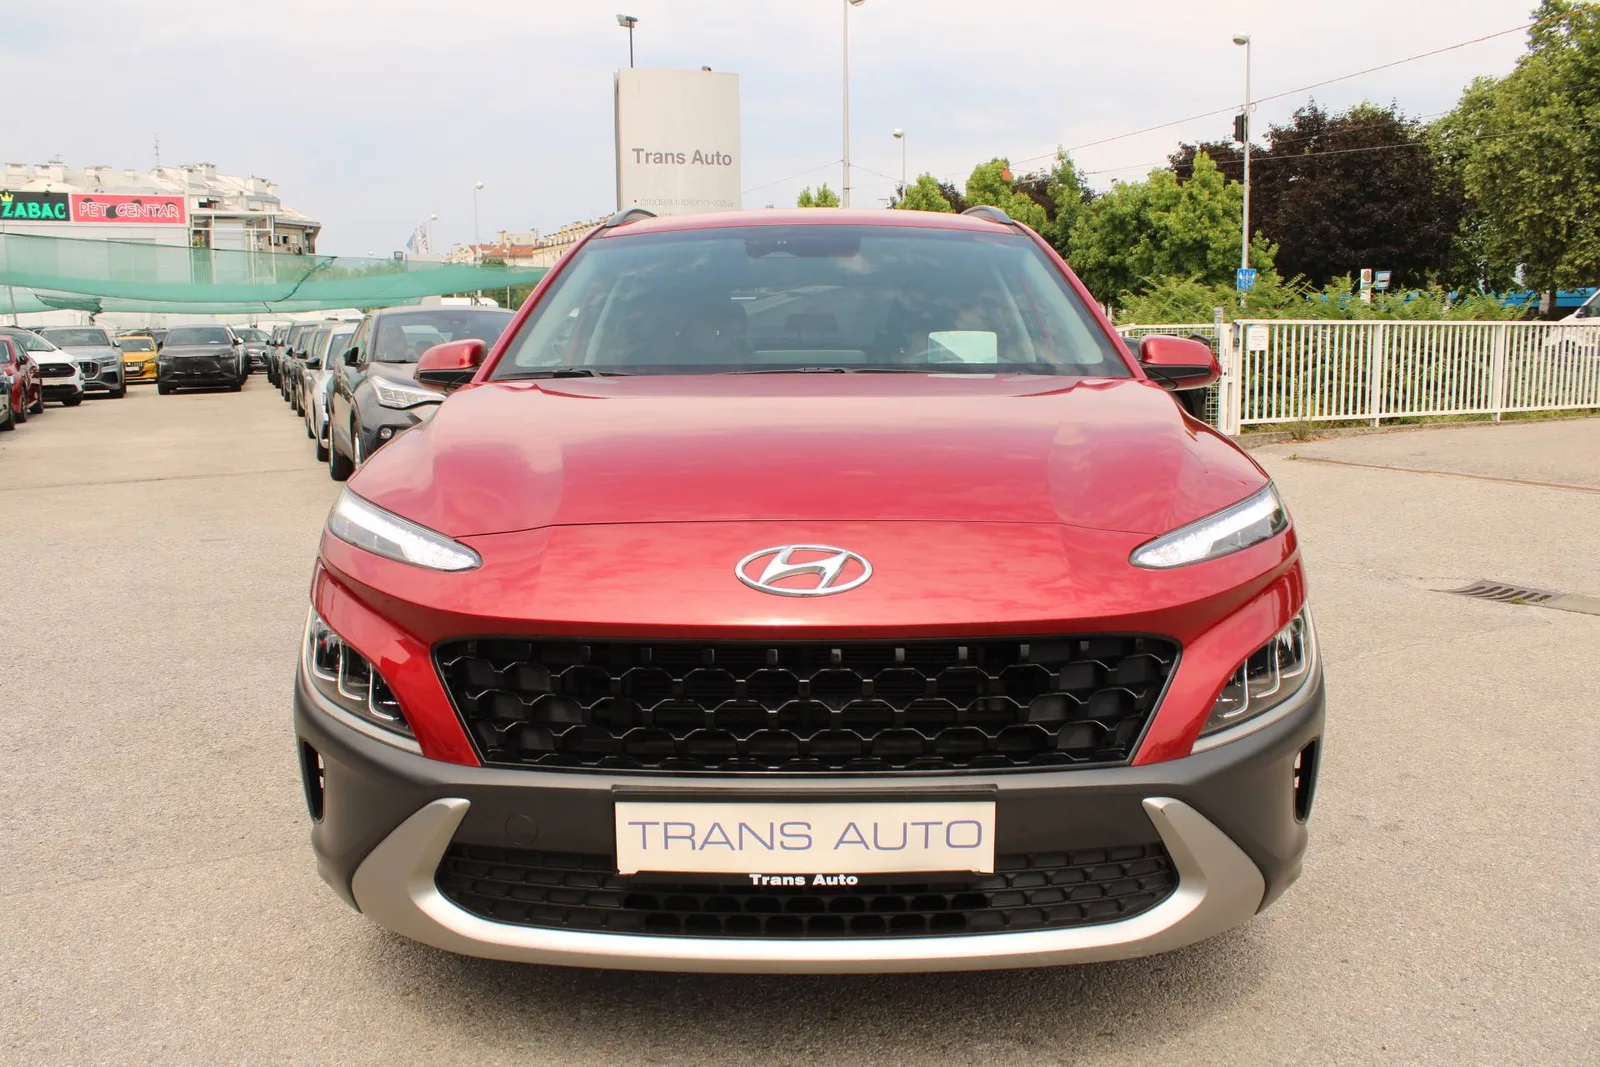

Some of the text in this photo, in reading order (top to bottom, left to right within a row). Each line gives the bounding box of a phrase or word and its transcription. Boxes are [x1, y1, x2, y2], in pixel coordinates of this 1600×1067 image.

[631, 148, 732, 166] Trans Auto
[79, 202, 180, 218] PET CENTAR
[628, 820, 983, 851] TRANS AUTO
[749, 874, 859, 886] Trans Auto
